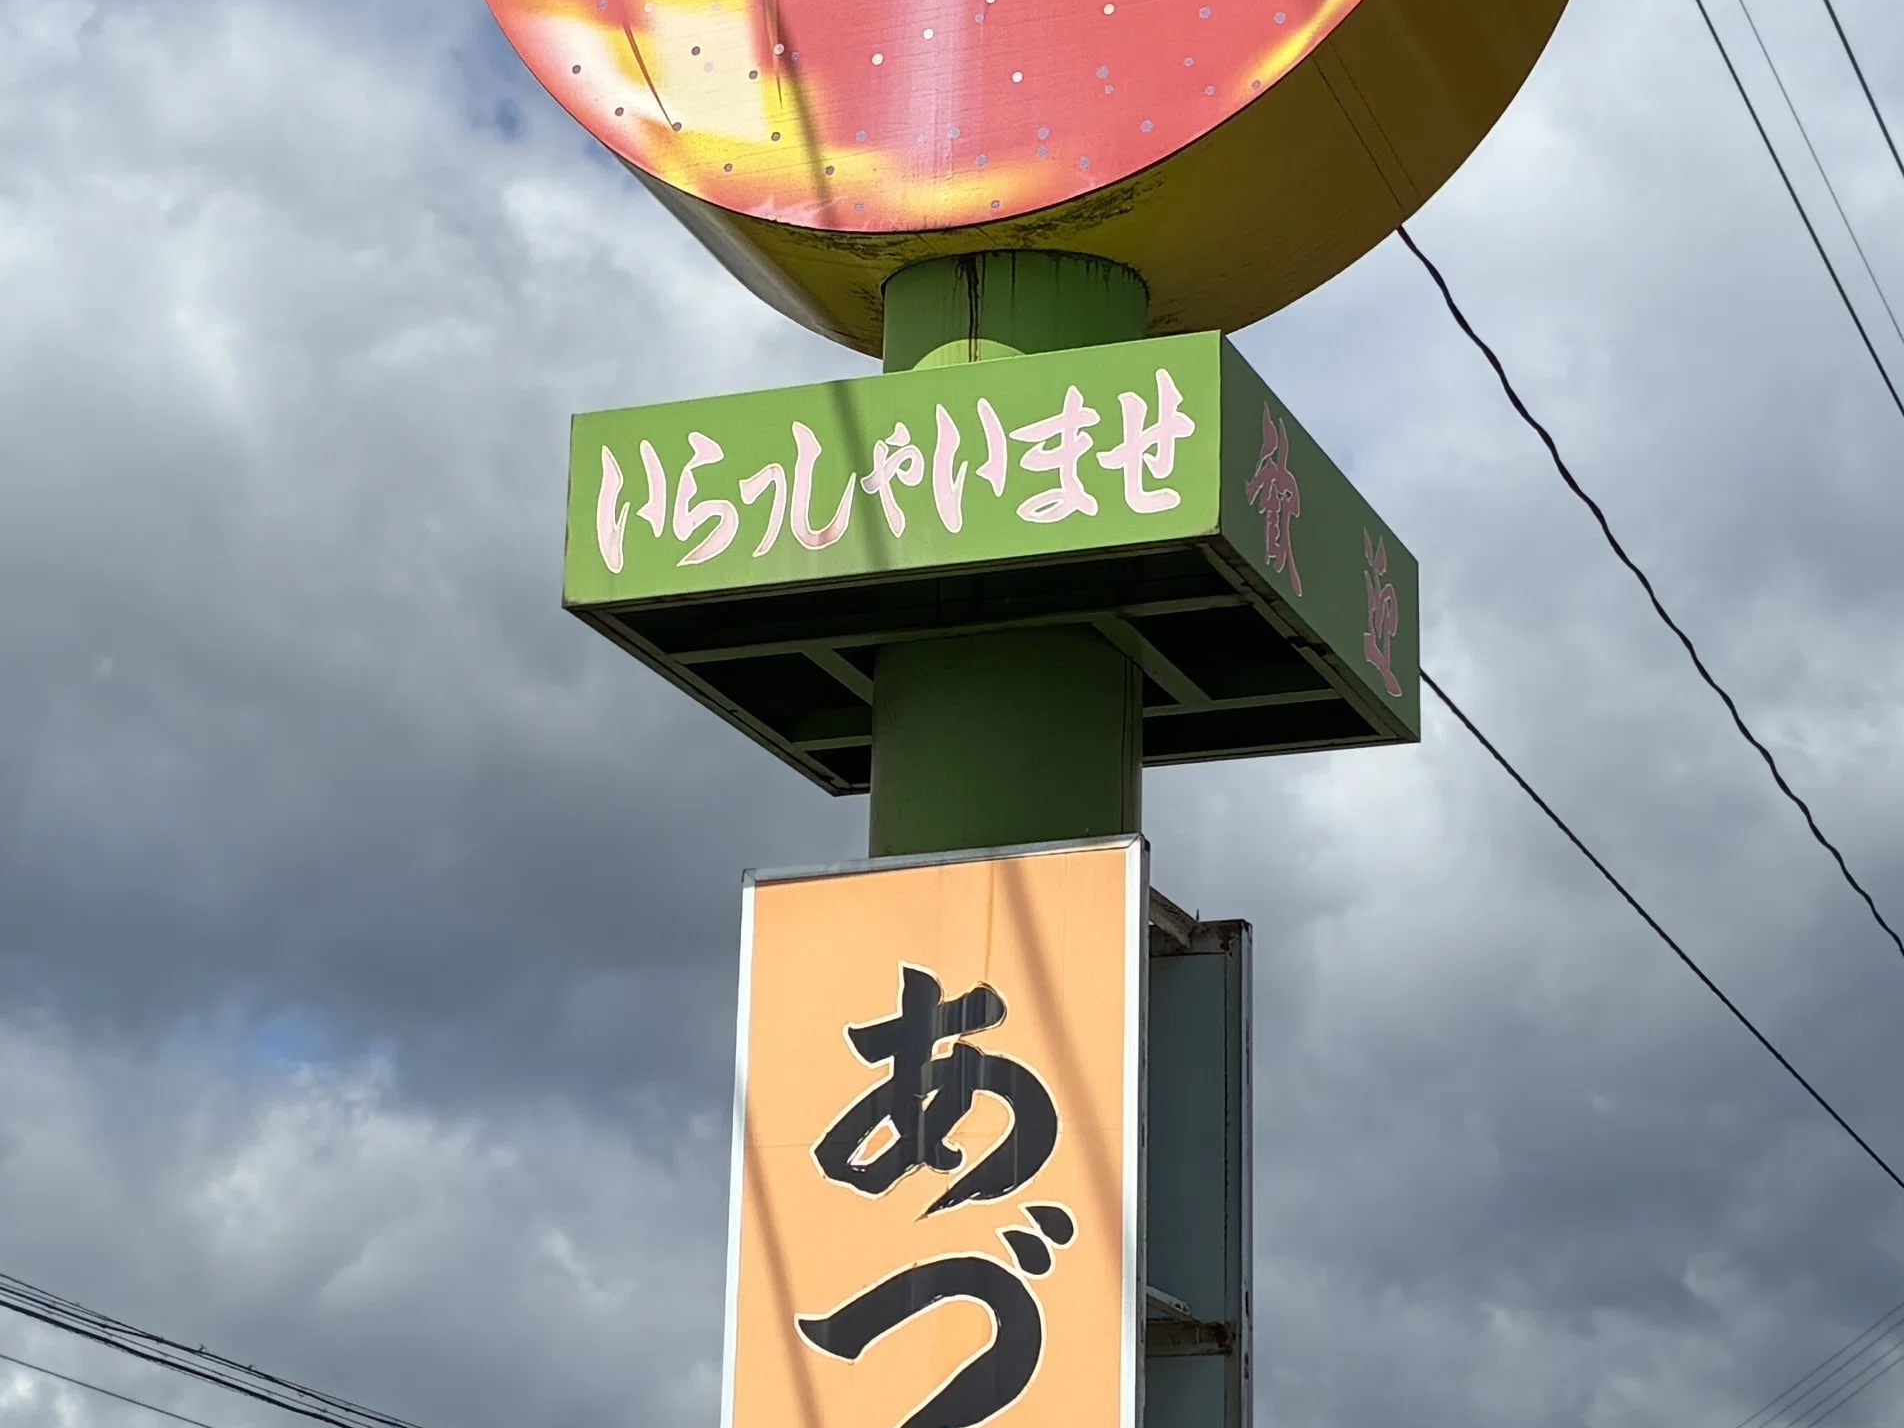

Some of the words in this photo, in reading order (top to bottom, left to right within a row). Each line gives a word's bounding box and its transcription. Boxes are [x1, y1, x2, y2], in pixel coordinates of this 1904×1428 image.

[595, 368, 1195, 575] いらっしゃいませ
